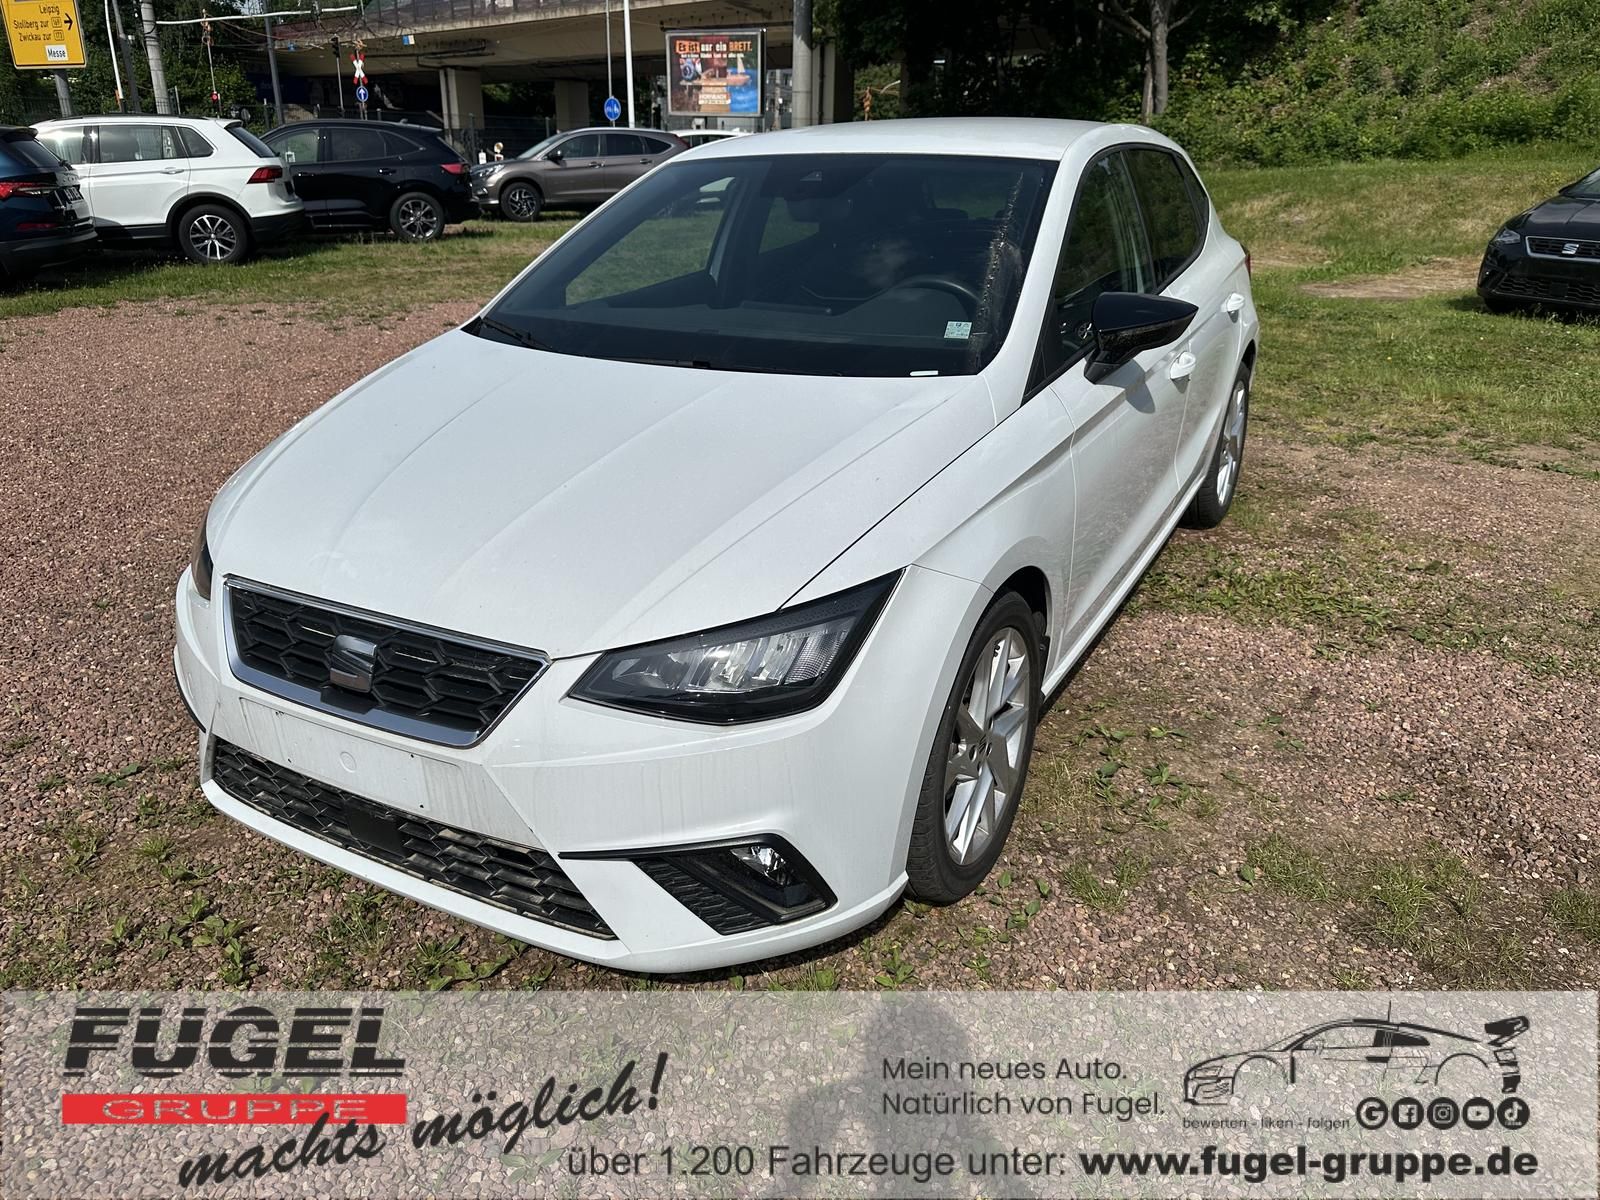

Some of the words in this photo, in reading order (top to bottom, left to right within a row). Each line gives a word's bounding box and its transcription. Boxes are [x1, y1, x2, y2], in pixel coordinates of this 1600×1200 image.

[40, 4, 60, 15] Leipzig
[19, 32, 41, 42] Zwickau
[678, 42, 686, 51] Es
[688, 42, 698, 52] ist
[716, 42, 727, 52] ein
[48, 48, 66, 58] Messe
